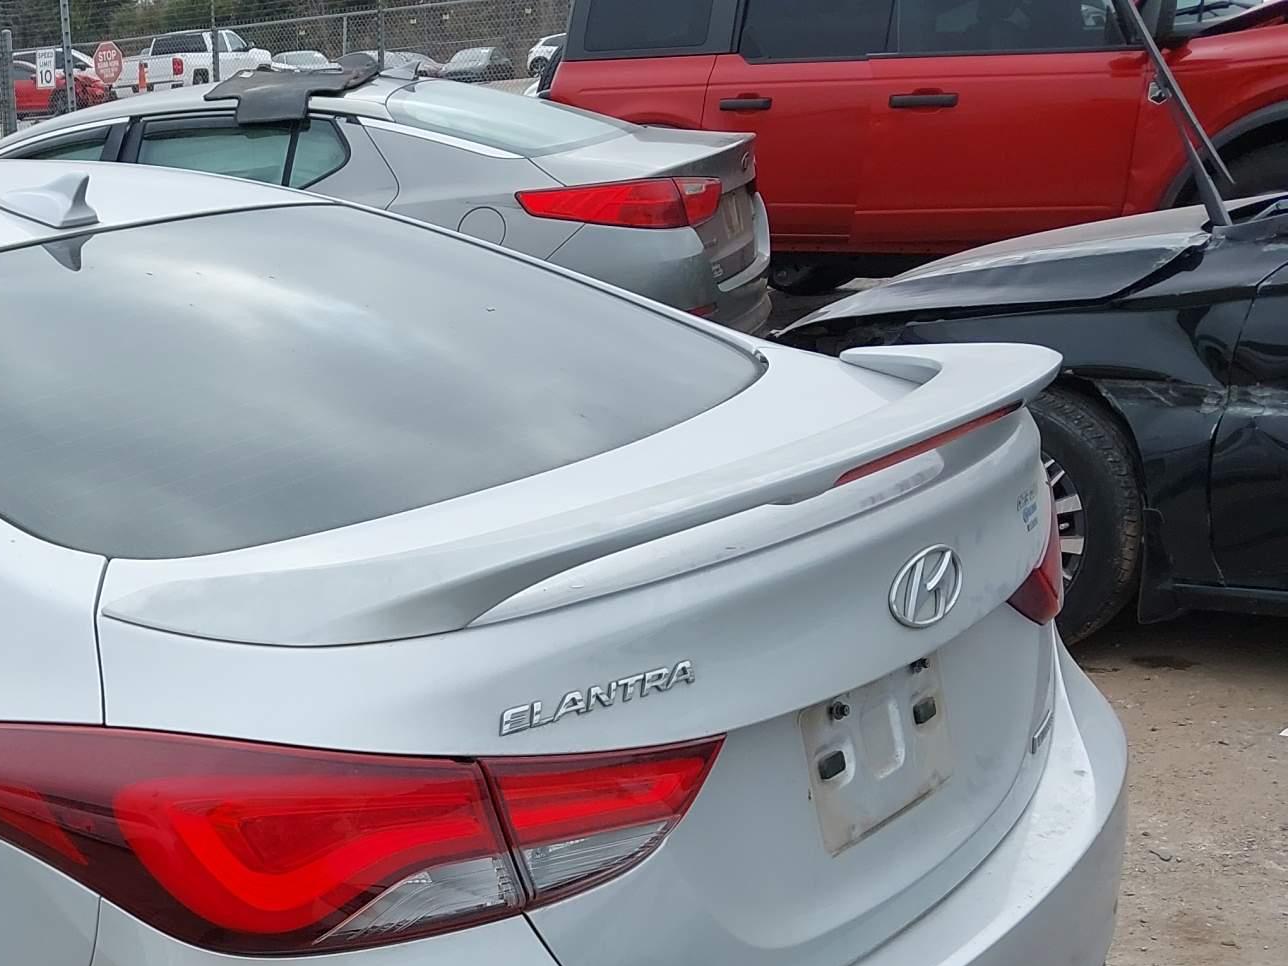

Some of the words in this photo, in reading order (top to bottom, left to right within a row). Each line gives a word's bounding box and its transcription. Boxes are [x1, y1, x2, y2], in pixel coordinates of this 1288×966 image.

[98, 49, 117, 62] STOP
[40, 60, 52, 68] LIMIT
[39, 69, 53, 85] 10
[498, 658, 696, 737] ELANTRA
